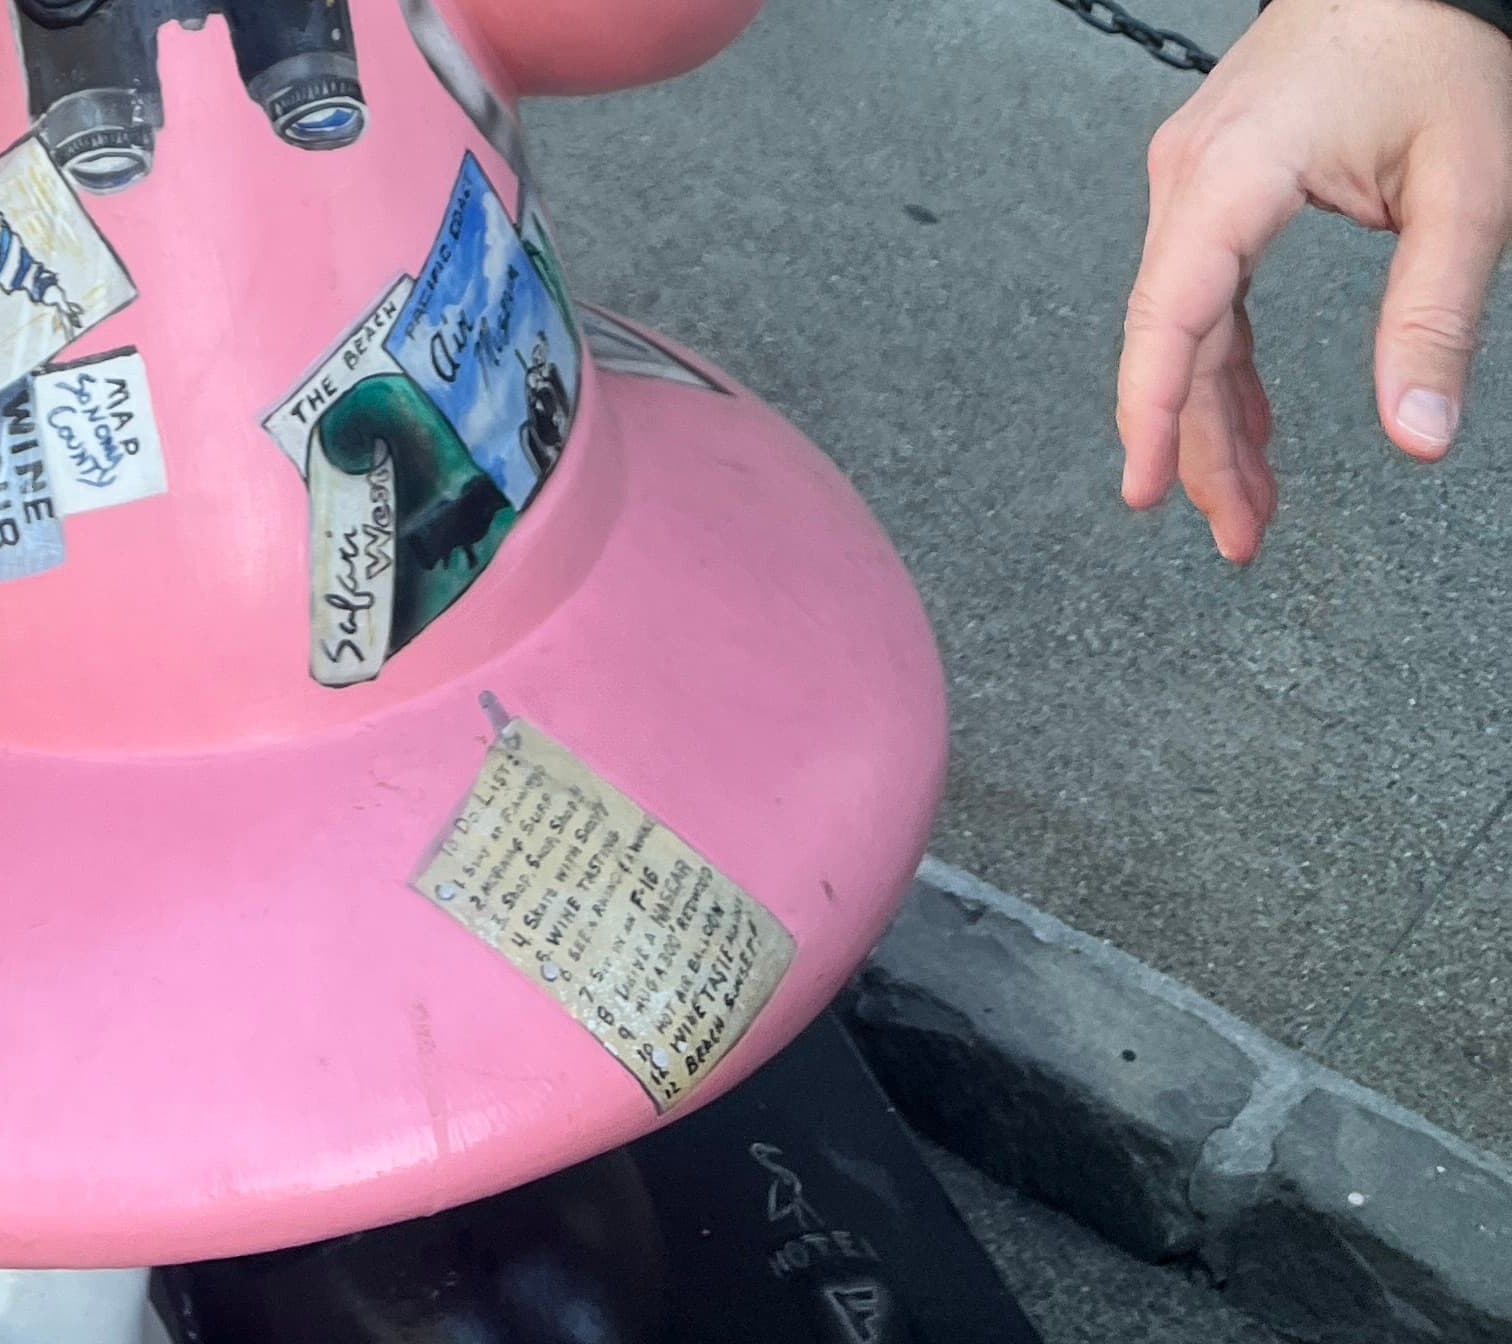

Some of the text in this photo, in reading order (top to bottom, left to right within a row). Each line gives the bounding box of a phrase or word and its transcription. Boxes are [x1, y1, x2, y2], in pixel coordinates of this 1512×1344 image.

[289, 299, 399, 425] THE BEACH
[430, 309, 474, 384] Air
[104, 377, 140, 456] MAP
[3, 390, 54, 525] WINE
[320, 526, 376, 664] Safari
[545, 896, 581, 946] WINE
[576, 830, 619, 891] TASTING
[630, 865, 659, 911] F-16
[648, 859, 694, 929] NASCAR
[676, 865, 713, 931] REDWOOD
[568, 928, 591, 962] SEE
[656, 1001, 677, 1034] HOT
[675, 974, 693, 1004] AIR
[687, 899, 726, 974] BALLOON
[664, 1081, 681, 1099] 12
[685, 1015, 726, 1076] BEACH
[669, 997, 707, 1053] WINE
